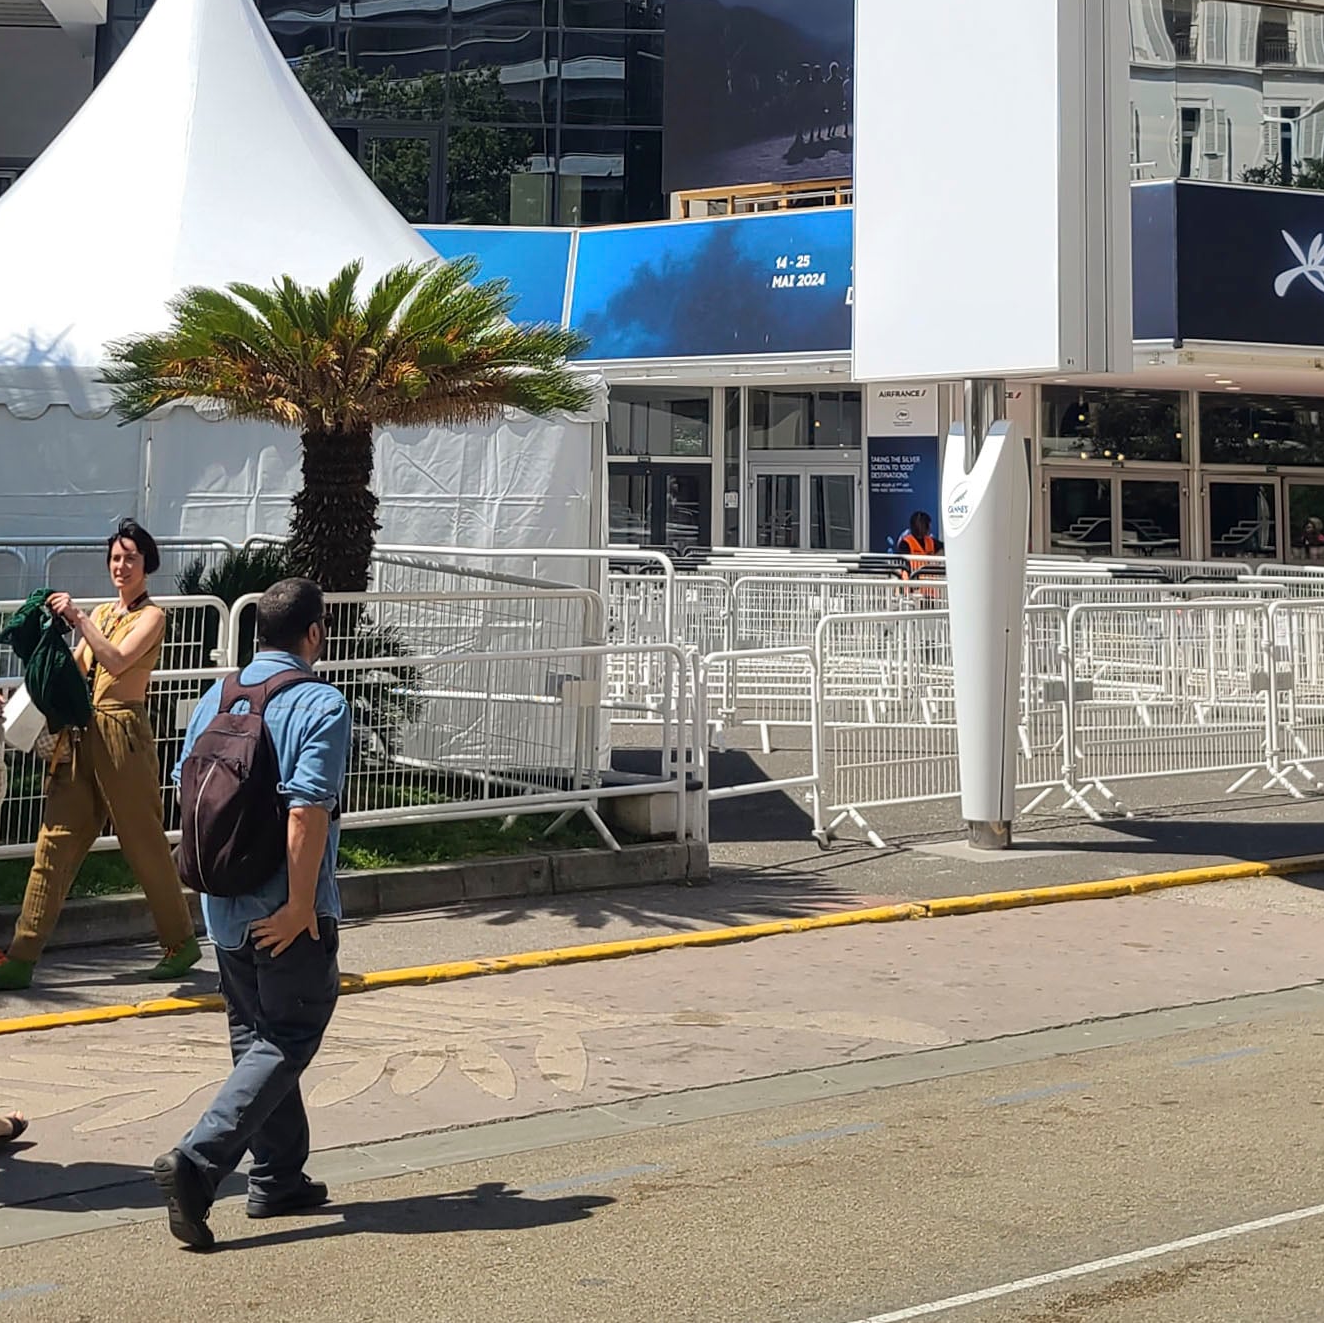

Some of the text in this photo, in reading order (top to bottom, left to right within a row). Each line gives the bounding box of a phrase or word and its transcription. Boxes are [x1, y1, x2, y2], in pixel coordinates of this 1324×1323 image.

[775, 255, 788, 269] 14
[795, 254, 811, 268] 25
[771, 272, 827, 289] MAI 2024
